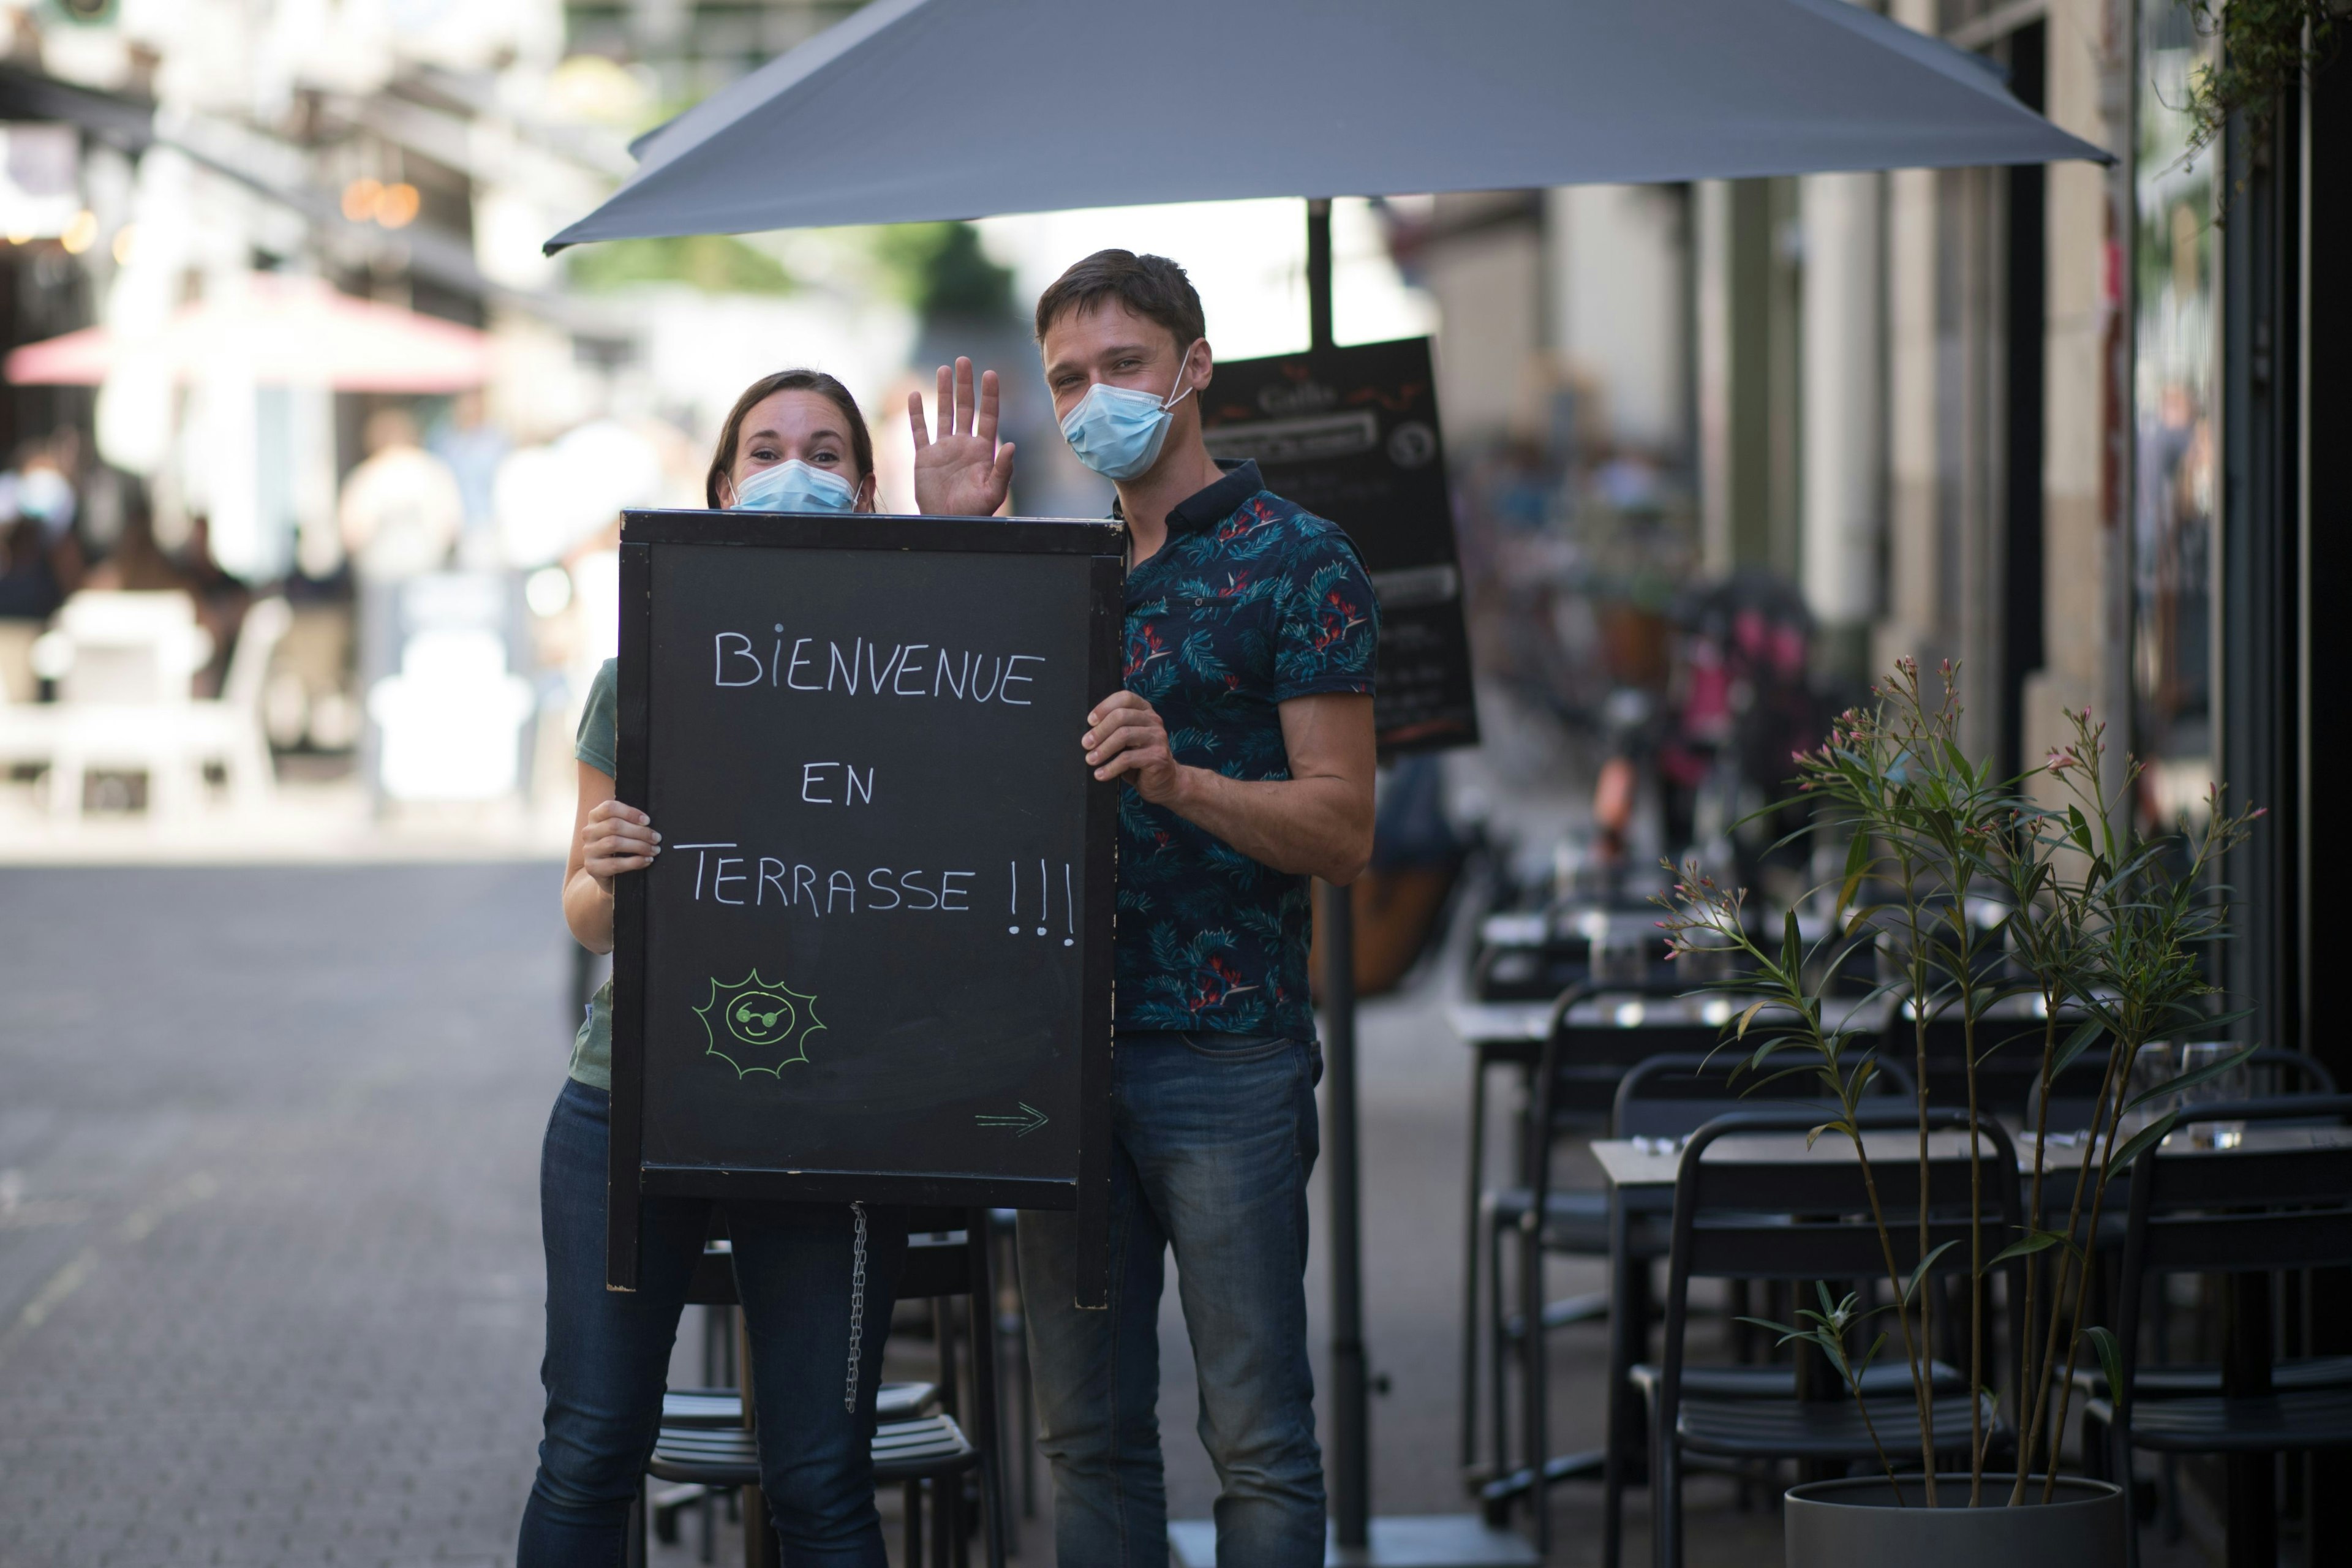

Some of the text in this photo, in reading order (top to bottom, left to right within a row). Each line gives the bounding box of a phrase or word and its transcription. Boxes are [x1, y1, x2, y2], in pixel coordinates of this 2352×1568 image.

[802, 762, 874, 807] EN
[673, 843, 1075, 947] TERRASSE !!!
